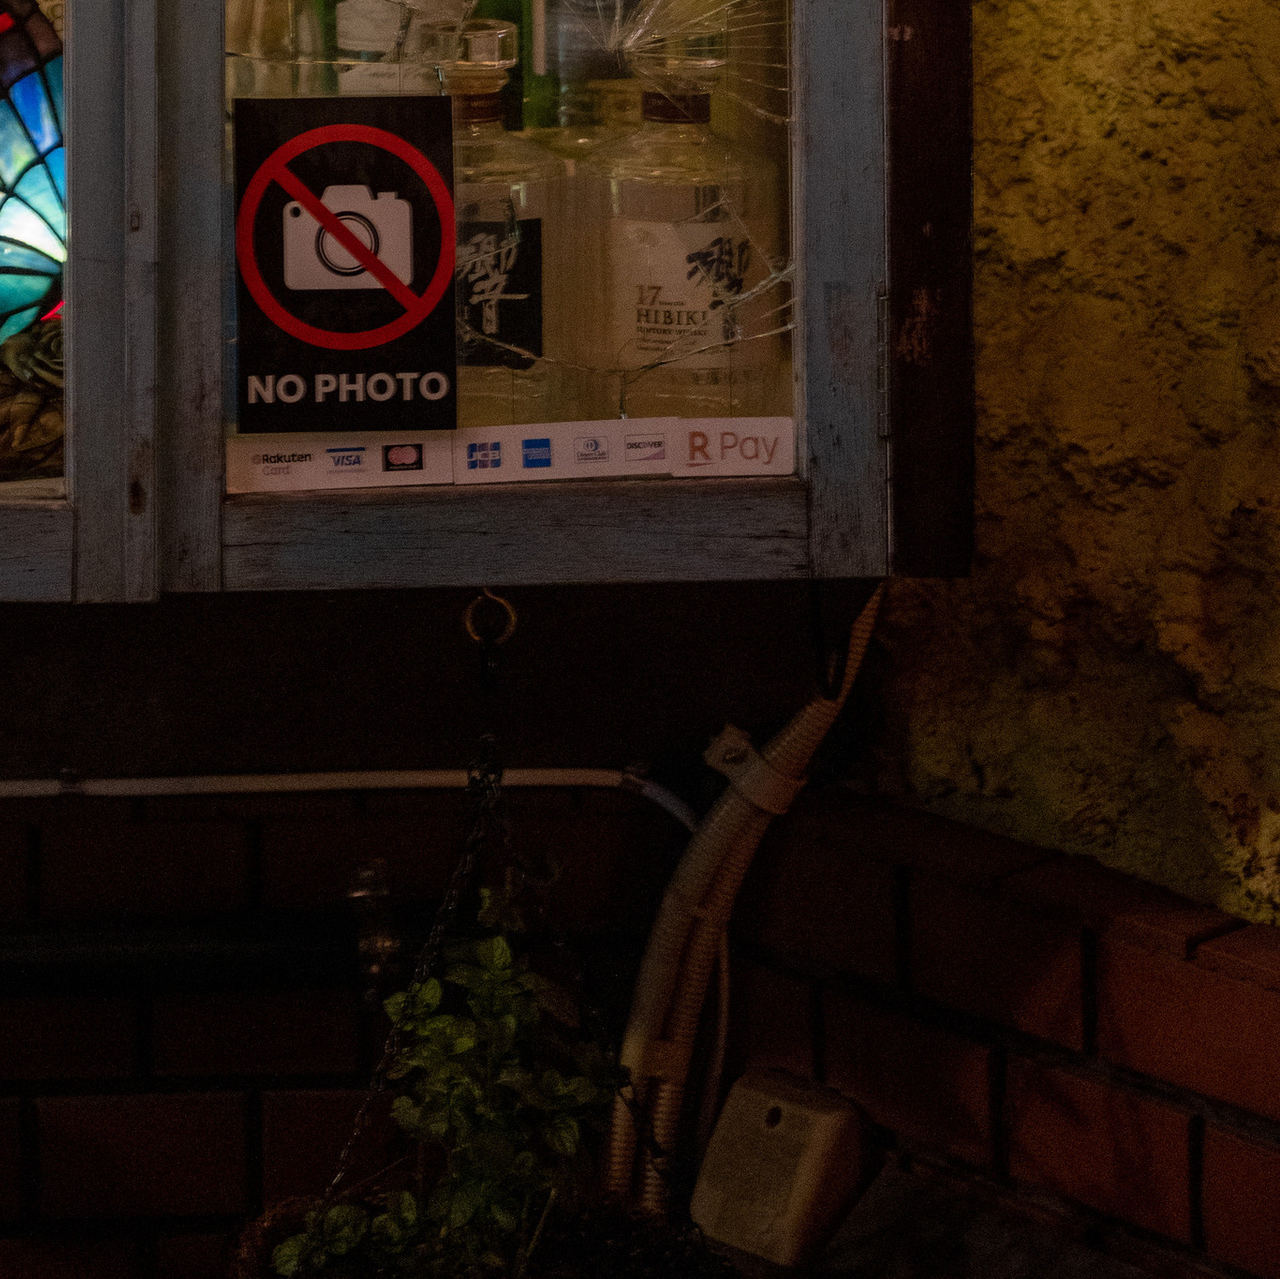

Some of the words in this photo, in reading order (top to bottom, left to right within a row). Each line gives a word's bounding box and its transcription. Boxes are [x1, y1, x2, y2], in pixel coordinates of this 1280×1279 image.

[637, 285, 662, 307] 17
[637, 308, 708, 326] HIBIKI
[636, 326, 673, 335] SUNTORY
[247, 374, 306, 404] NO
[315, 371, 451, 403] PHOTO
[626, 441, 663, 450] DISCOVER
[687, 431, 712, 461] R
[720, 431, 781, 465] Pay
[261, 452, 312, 465] Rakuten
[331, 455, 362, 467] VISA
[466, 450, 500, 462] JCB
[262, 464, 291, 476] Card
